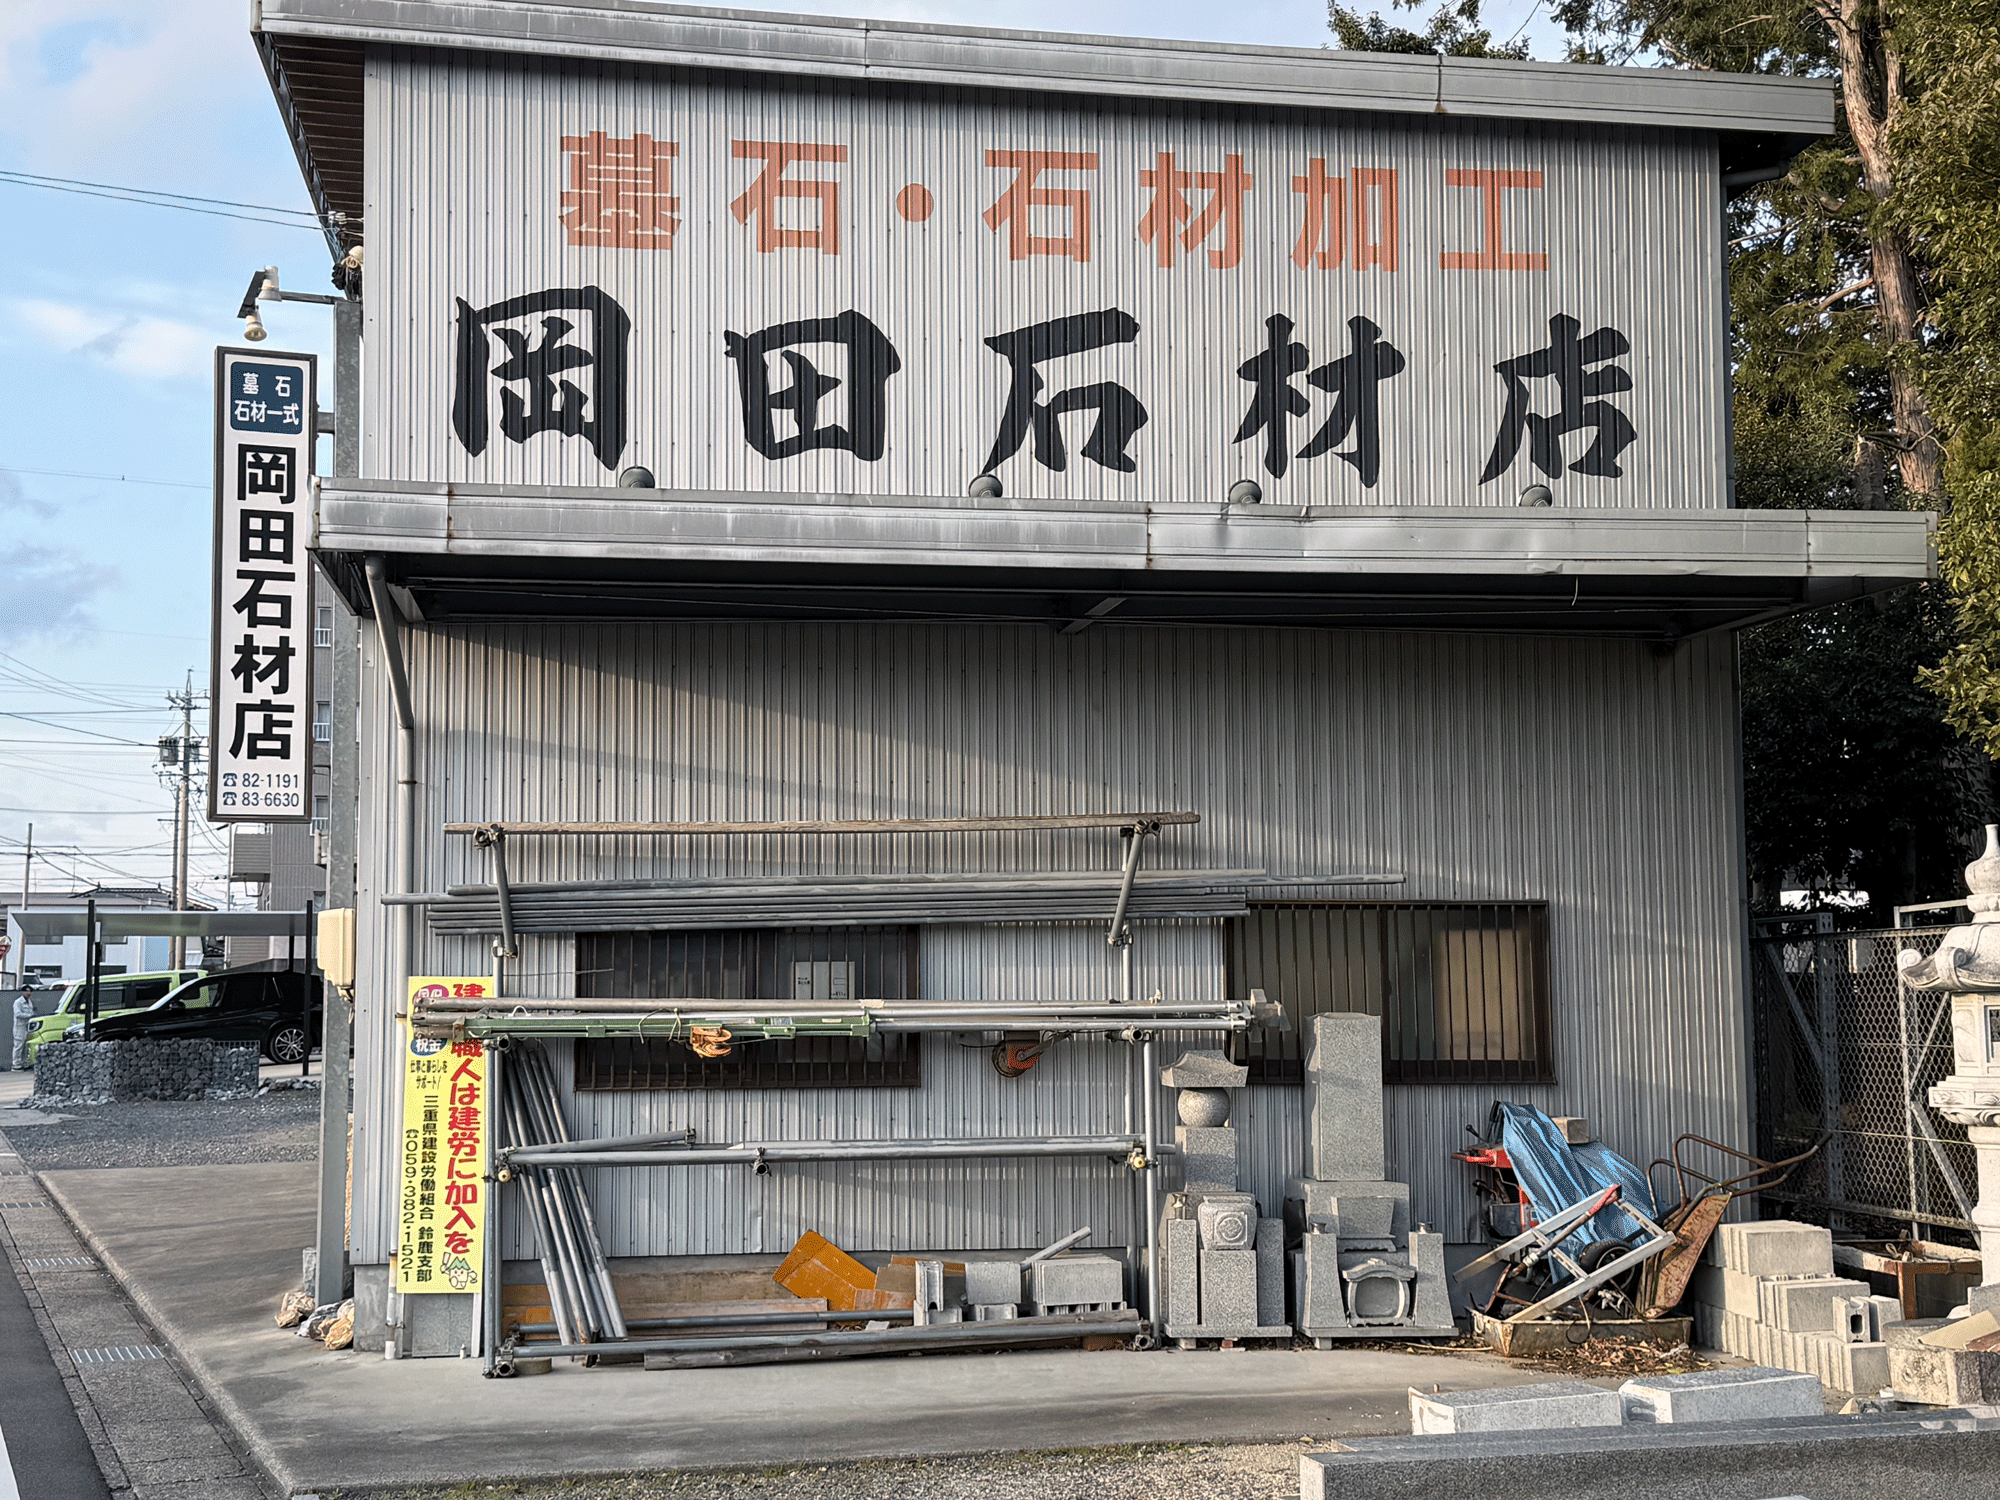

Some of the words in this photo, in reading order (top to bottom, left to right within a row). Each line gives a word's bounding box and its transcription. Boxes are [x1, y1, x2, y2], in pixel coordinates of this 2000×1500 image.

[559, 131, 1549, 272] 墓石・石材加工
[234, 399, 300, 426] 石材一式
[452, 285, 1638, 488] 岡田石材店
[228, 443, 297, 760] 岡田石材店
[241, 791, 300, 807] 83-6630
[242, 772, 299, 788] 82-1191
[419, 1095, 439, 1220] 三重県建設労働組合
[416, 1226, 435, 1283] 鈴鹿支部
